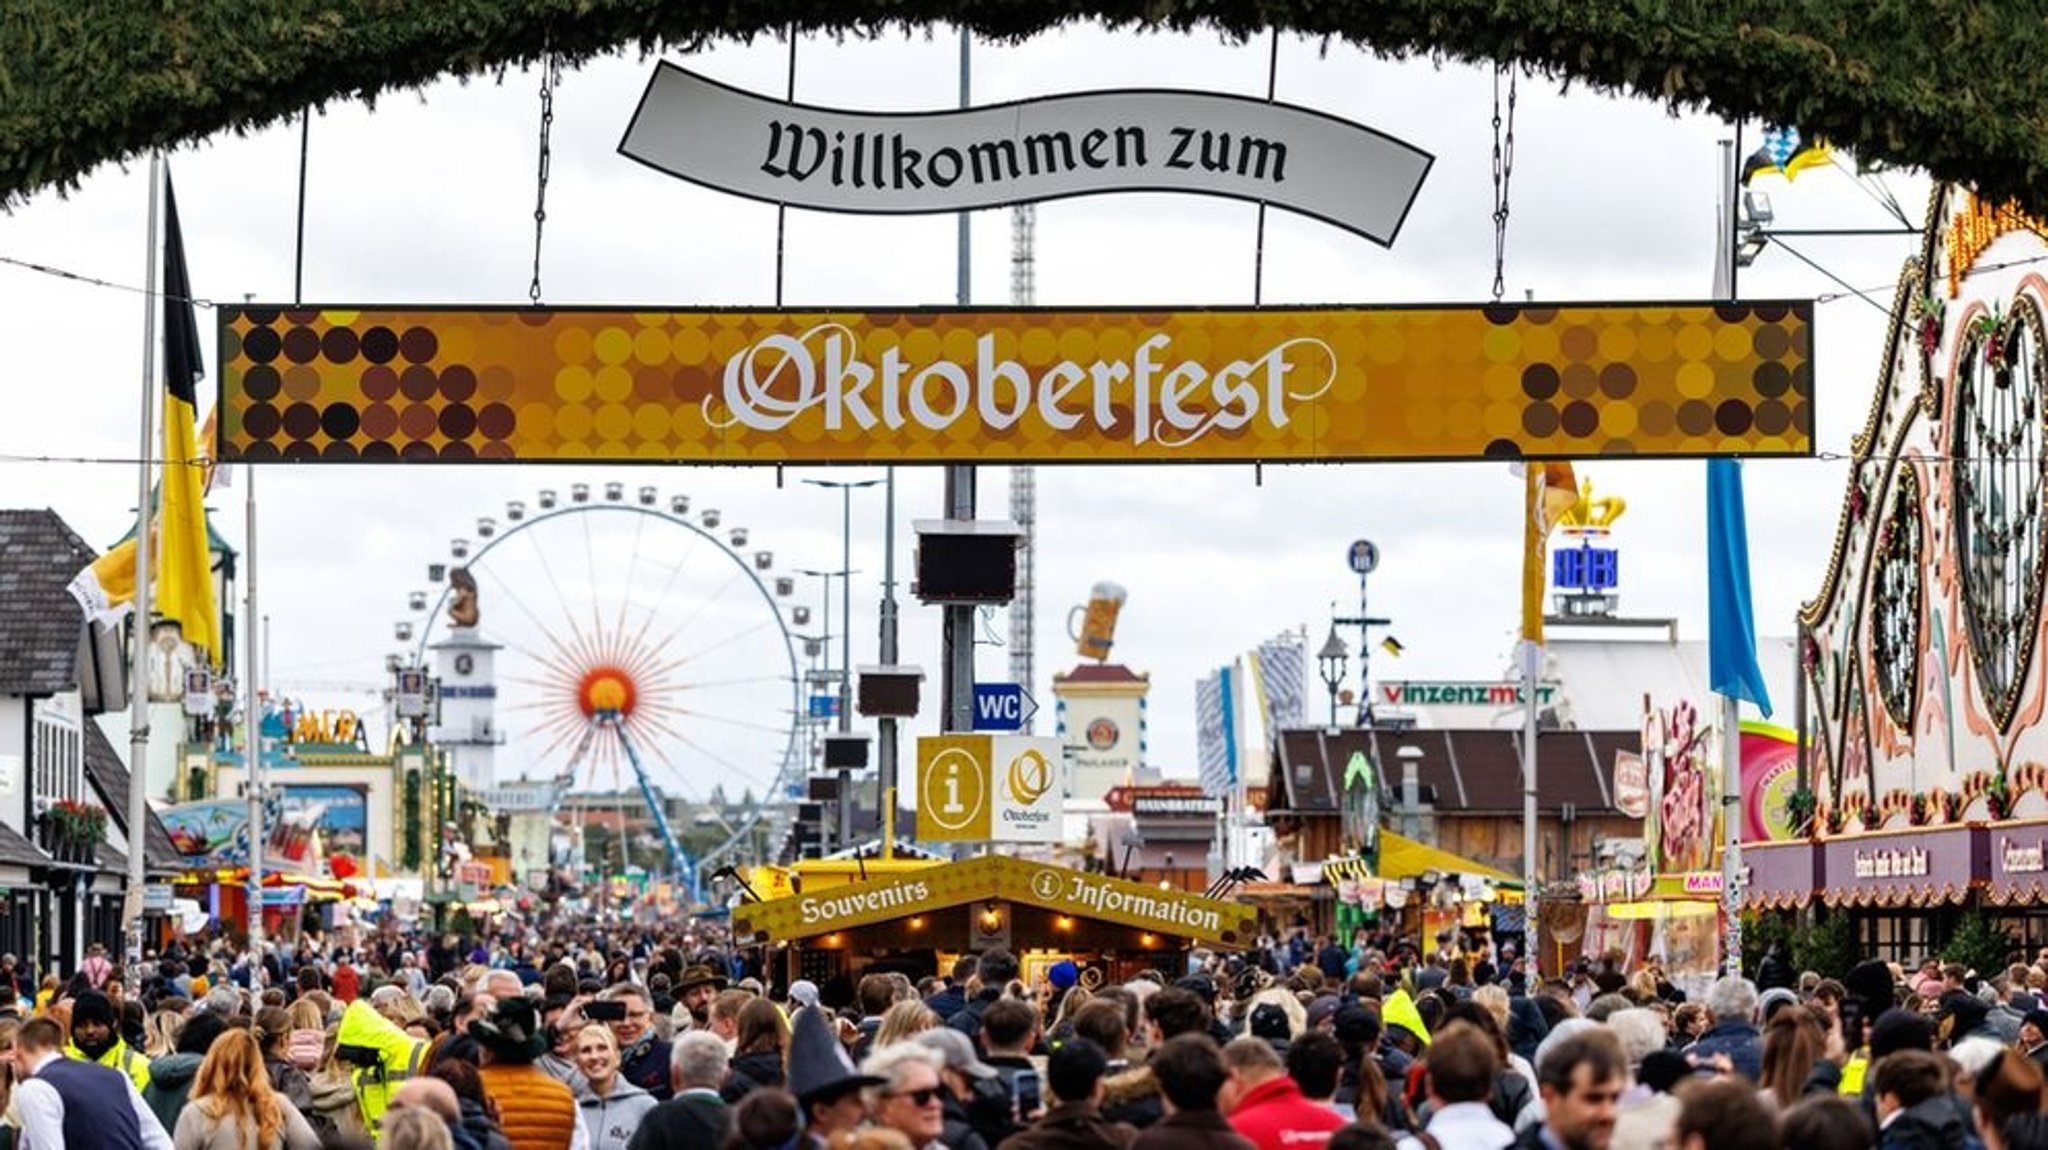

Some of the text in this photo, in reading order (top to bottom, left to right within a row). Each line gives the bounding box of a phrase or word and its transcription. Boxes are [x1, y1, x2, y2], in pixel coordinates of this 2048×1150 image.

[761, 120, 1288, 190] Willkommen zum
[703, 322, 1337, 447] Oktoberfest
[978, 694, 1019, 719] WC
[801, 879, 929, 924] Souvenirs
[1066, 877, 1221, 931] Information
